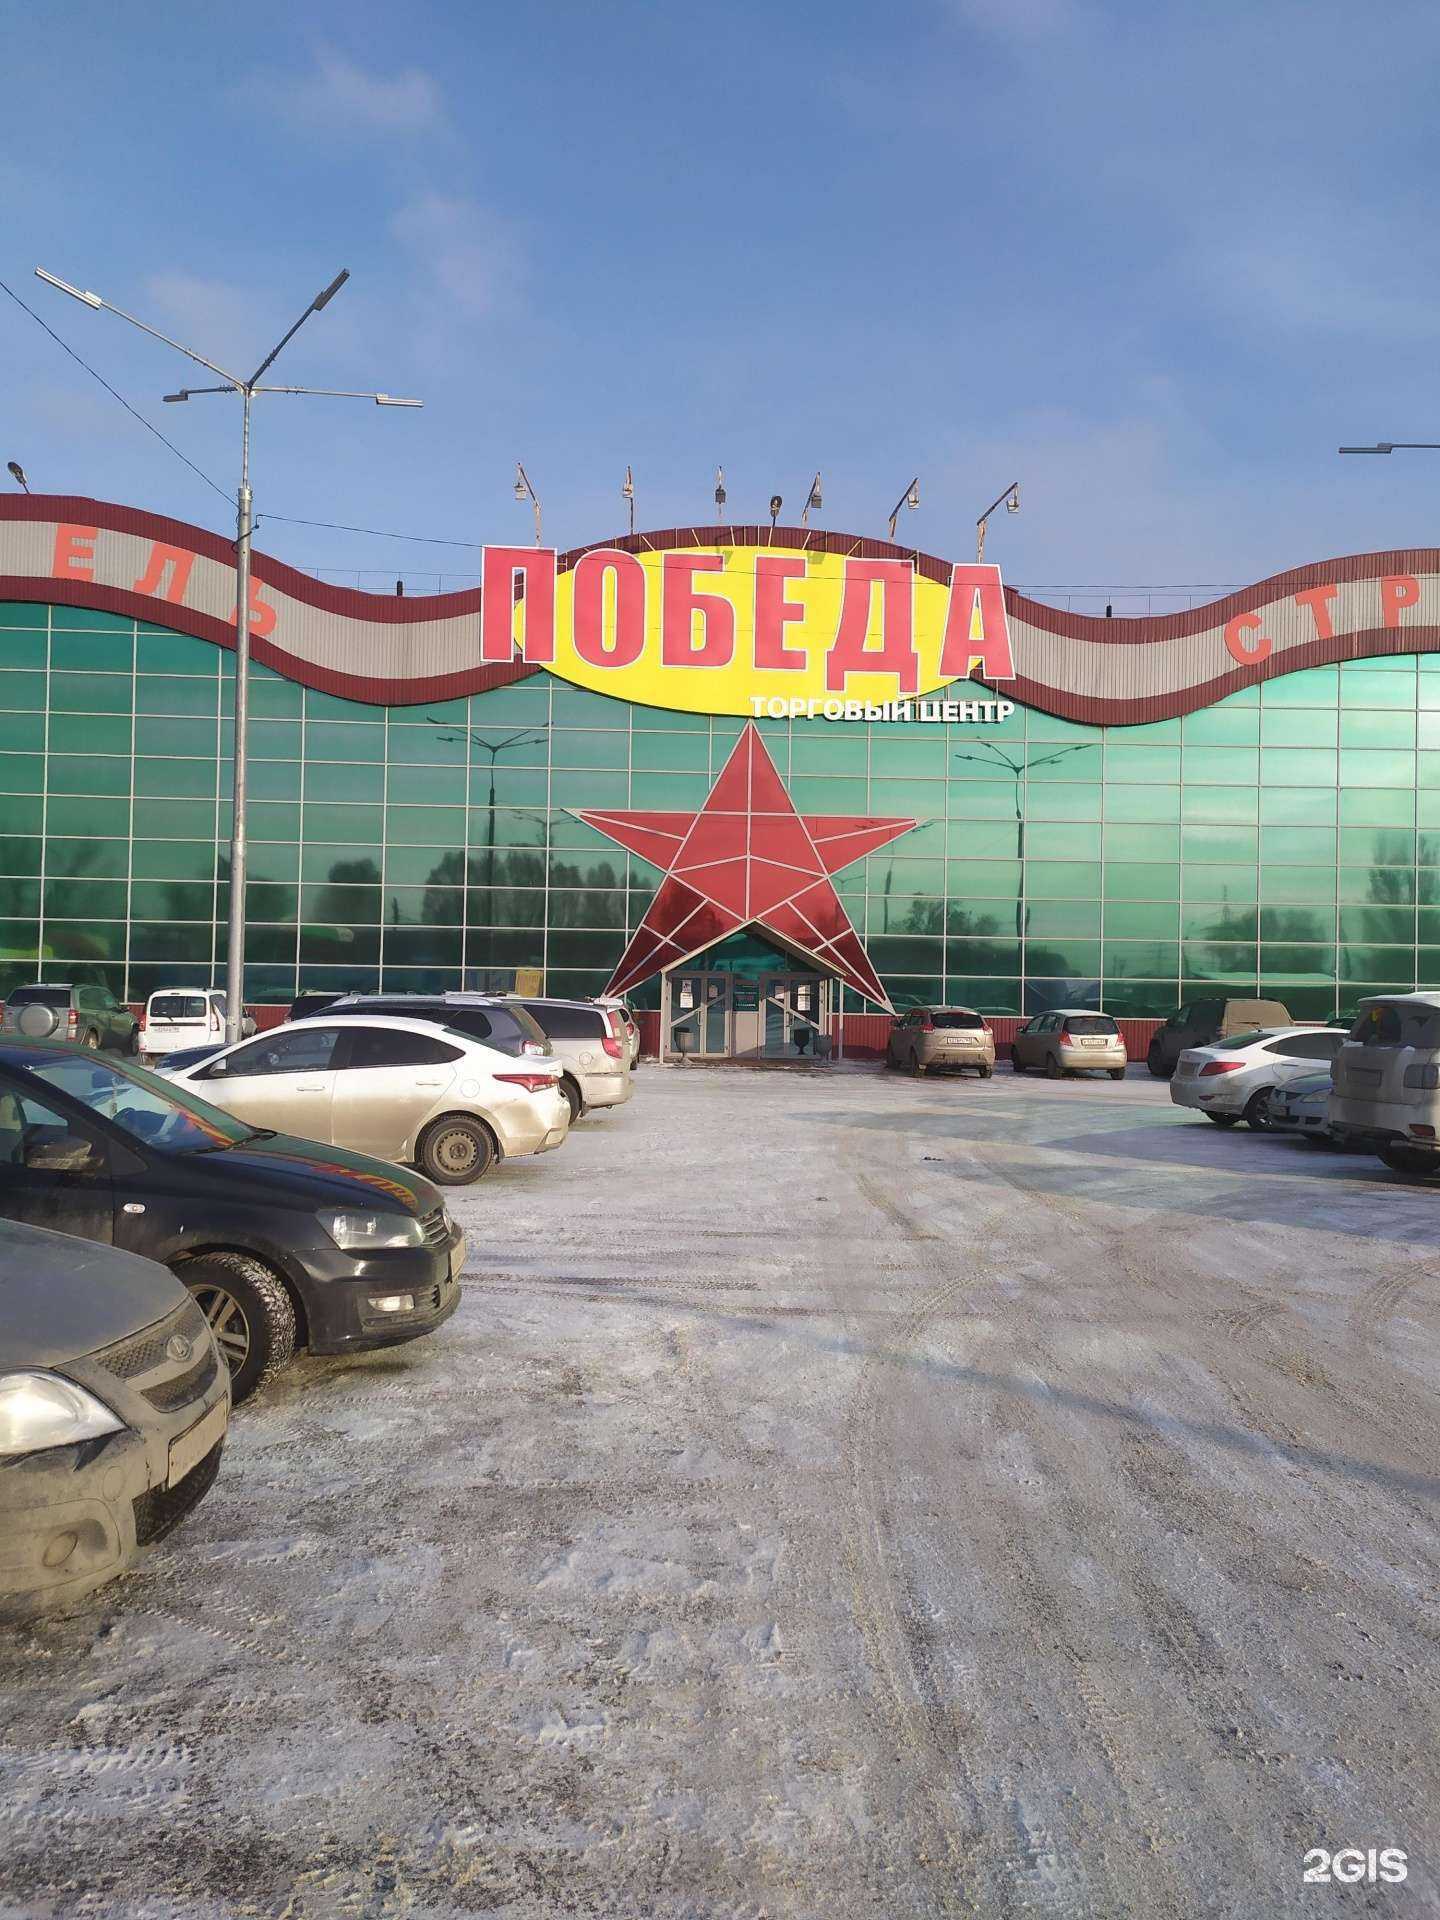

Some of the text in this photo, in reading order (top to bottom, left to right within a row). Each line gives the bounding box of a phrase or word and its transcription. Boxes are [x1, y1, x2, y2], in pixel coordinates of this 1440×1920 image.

[481, 545, 1016, 694] ПОБЕДА
[1224, 575, 1420, 665] СТР
[750, 694, 1015, 723] ТОРГОВЫЙ ЦЕНТР
